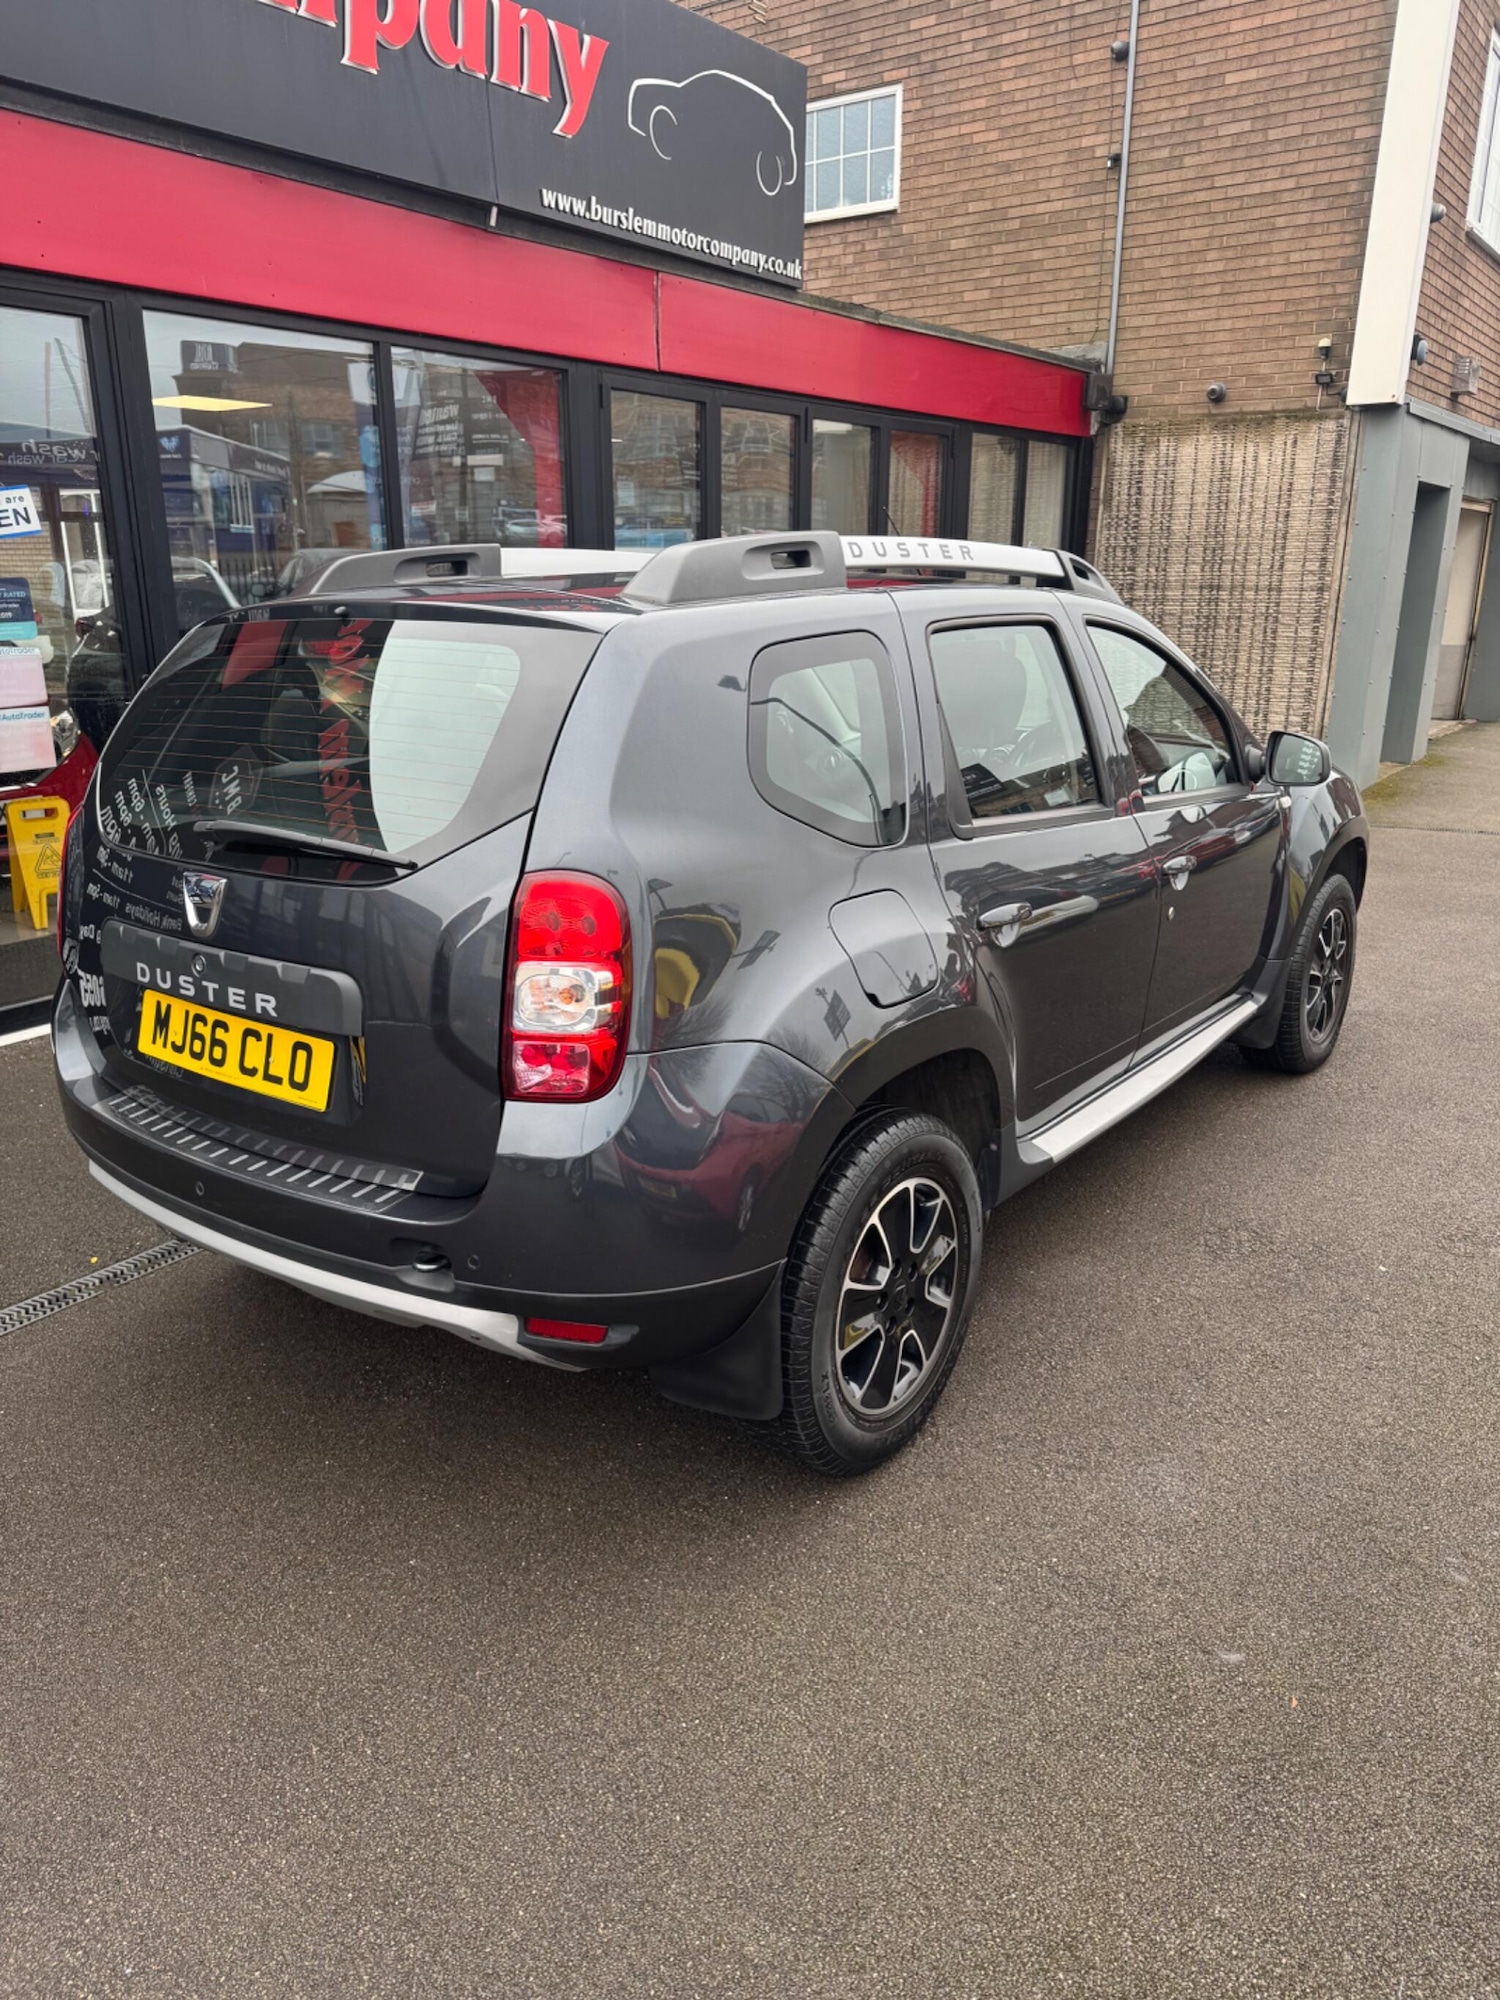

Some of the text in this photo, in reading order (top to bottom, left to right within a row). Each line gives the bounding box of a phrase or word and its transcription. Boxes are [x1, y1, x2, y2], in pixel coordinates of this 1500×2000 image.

[250, 0, 609, 138] pany
[540, 187, 802, 280] www.burslemmotorcompany.co.uk
[848, 541, 974, 561] DUSTER
[136, 962, 278, 1017] DUSTER
[151, 1000, 230, 1069] MJ66
[238, 1027, 314, 1092] CLO
